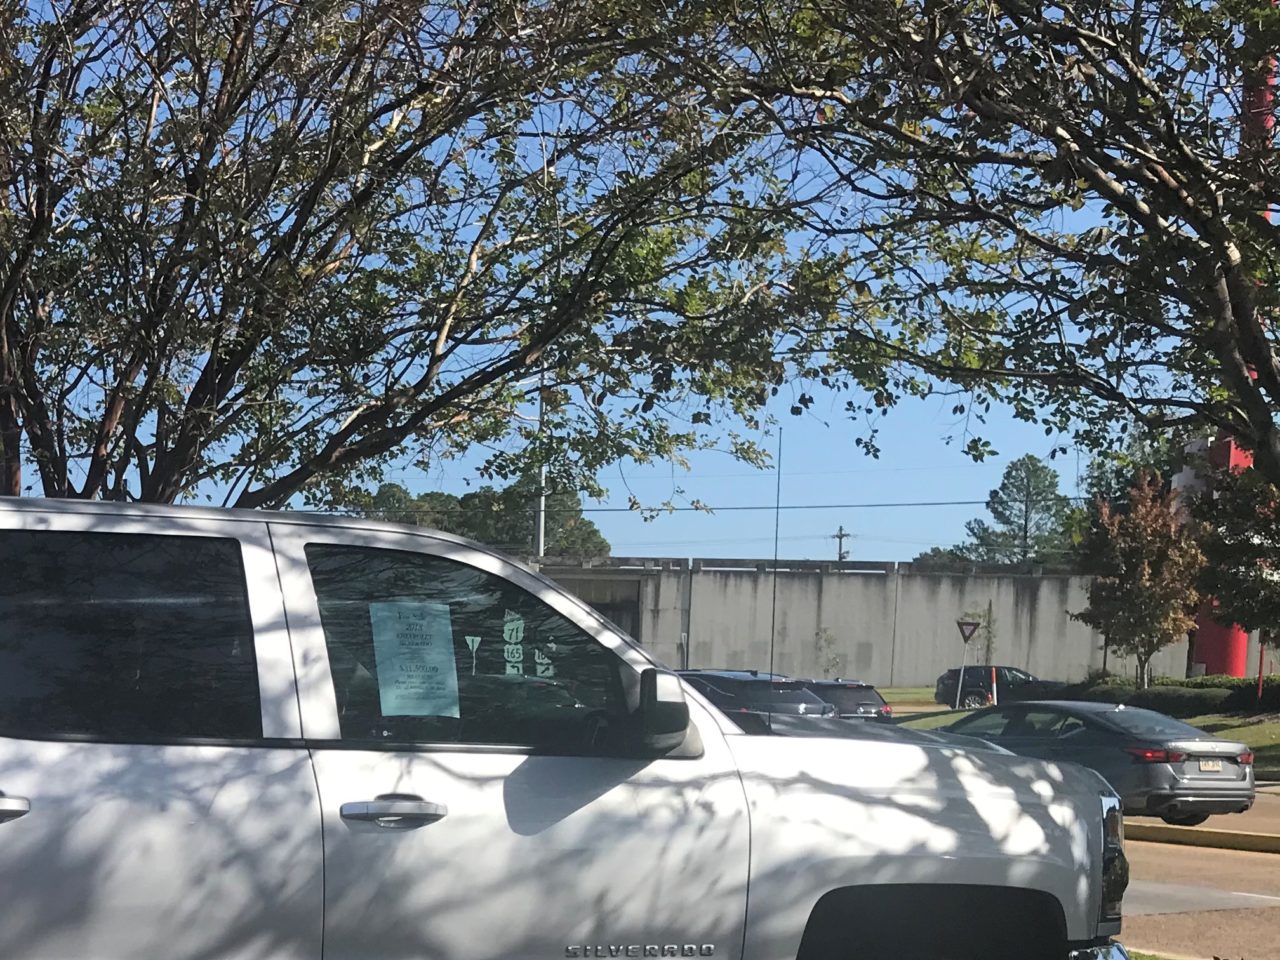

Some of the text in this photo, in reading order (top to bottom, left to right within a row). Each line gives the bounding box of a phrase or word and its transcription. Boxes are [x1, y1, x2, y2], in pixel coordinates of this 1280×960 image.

[507, 626, 520, 641] 71
[506, 648, 521, 659] 165
[565, 943, 716, 958] SILVERADO
